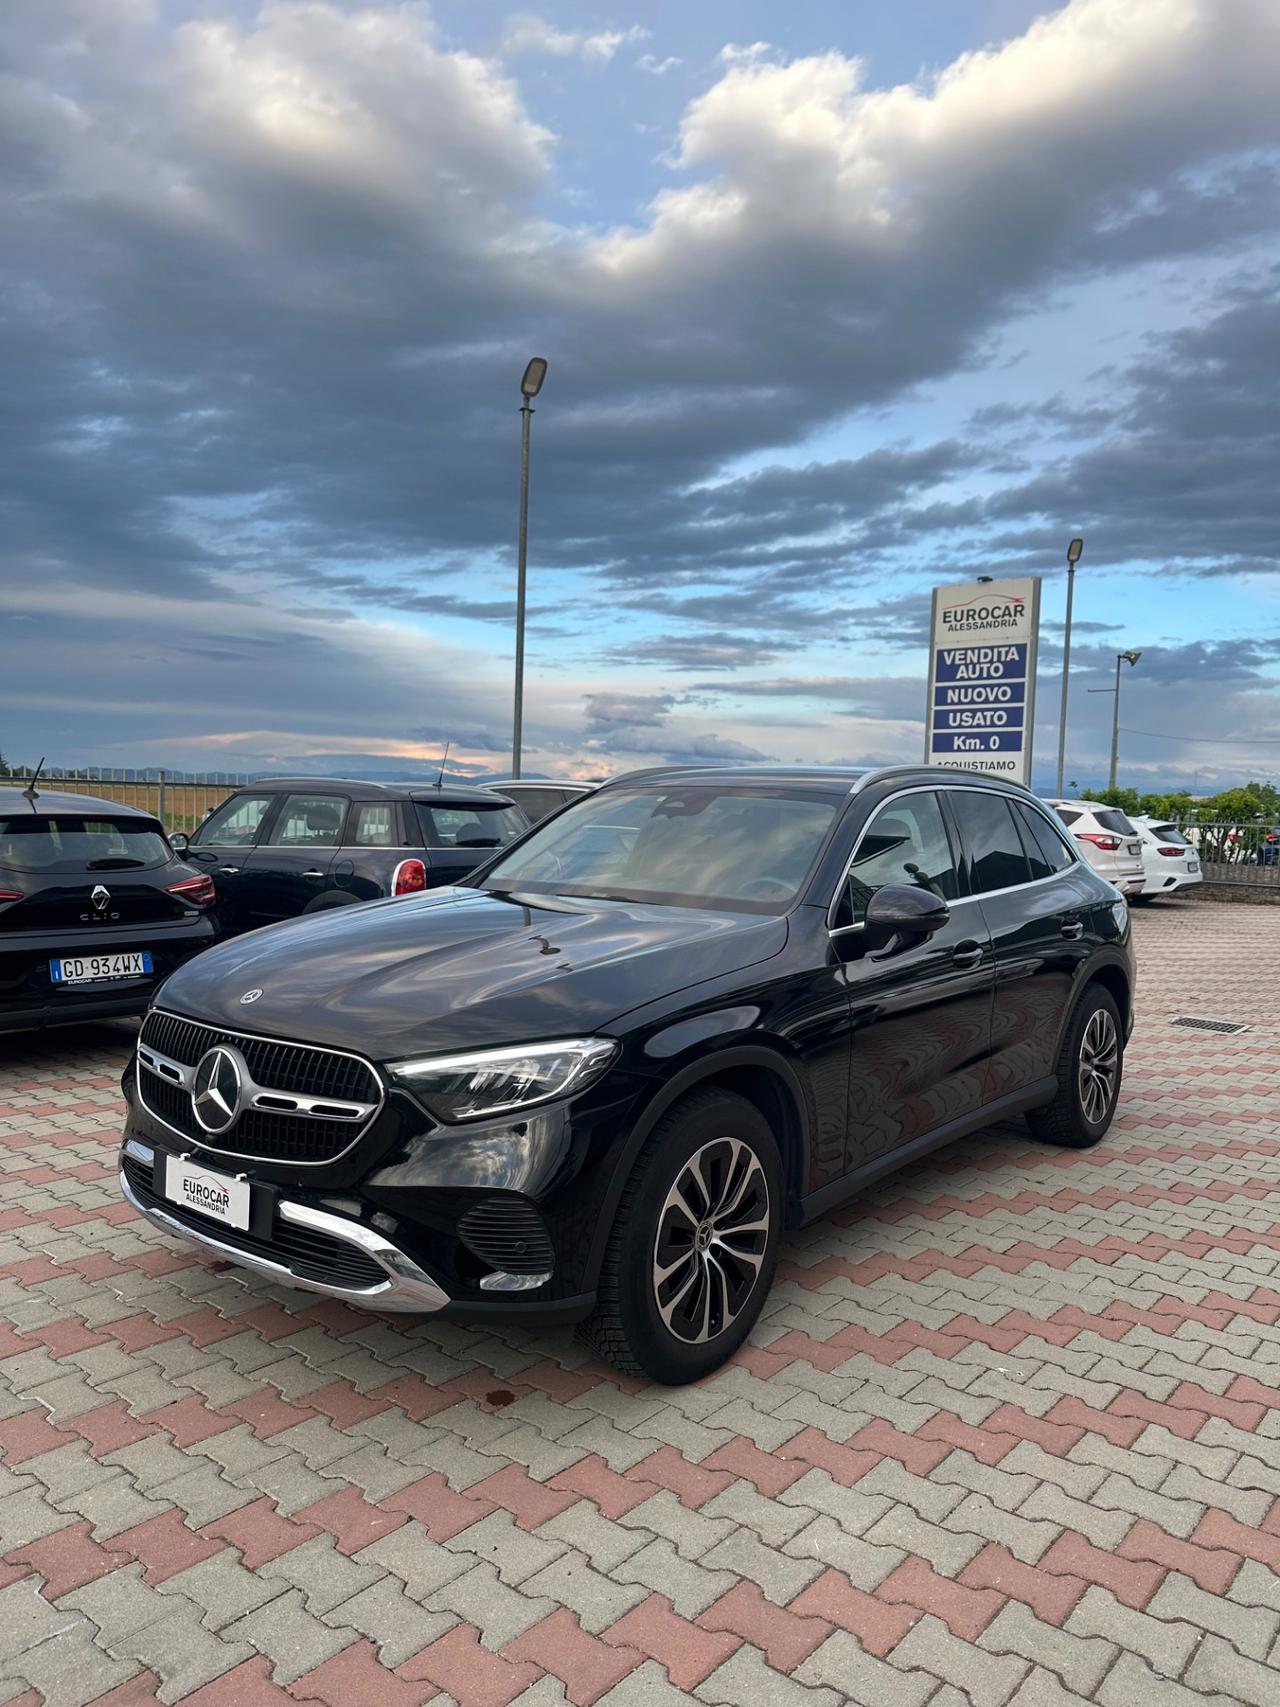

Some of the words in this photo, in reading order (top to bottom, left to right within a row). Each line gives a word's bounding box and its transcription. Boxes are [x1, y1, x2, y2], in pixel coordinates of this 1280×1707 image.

[942, 604, 1025, 624] EUROCAR
[947, 620, 1018, 632] ALESSANDRIA
[943, 646, 1020, 665] VENDITA
[956, 662, 1004, 679] AUTO
[947, 686, 1012, 704] NUOVO
[949, 711, 1007, 727] USATO
[953, 736, 985, 751] Km.
[989, 736, 1000, 750] 0
[63, 960, 84, 978] GD
[183, 1179, 230, 1208] EUROCAR
[185, 1193, 226, 1215] ALESSANDRIA
